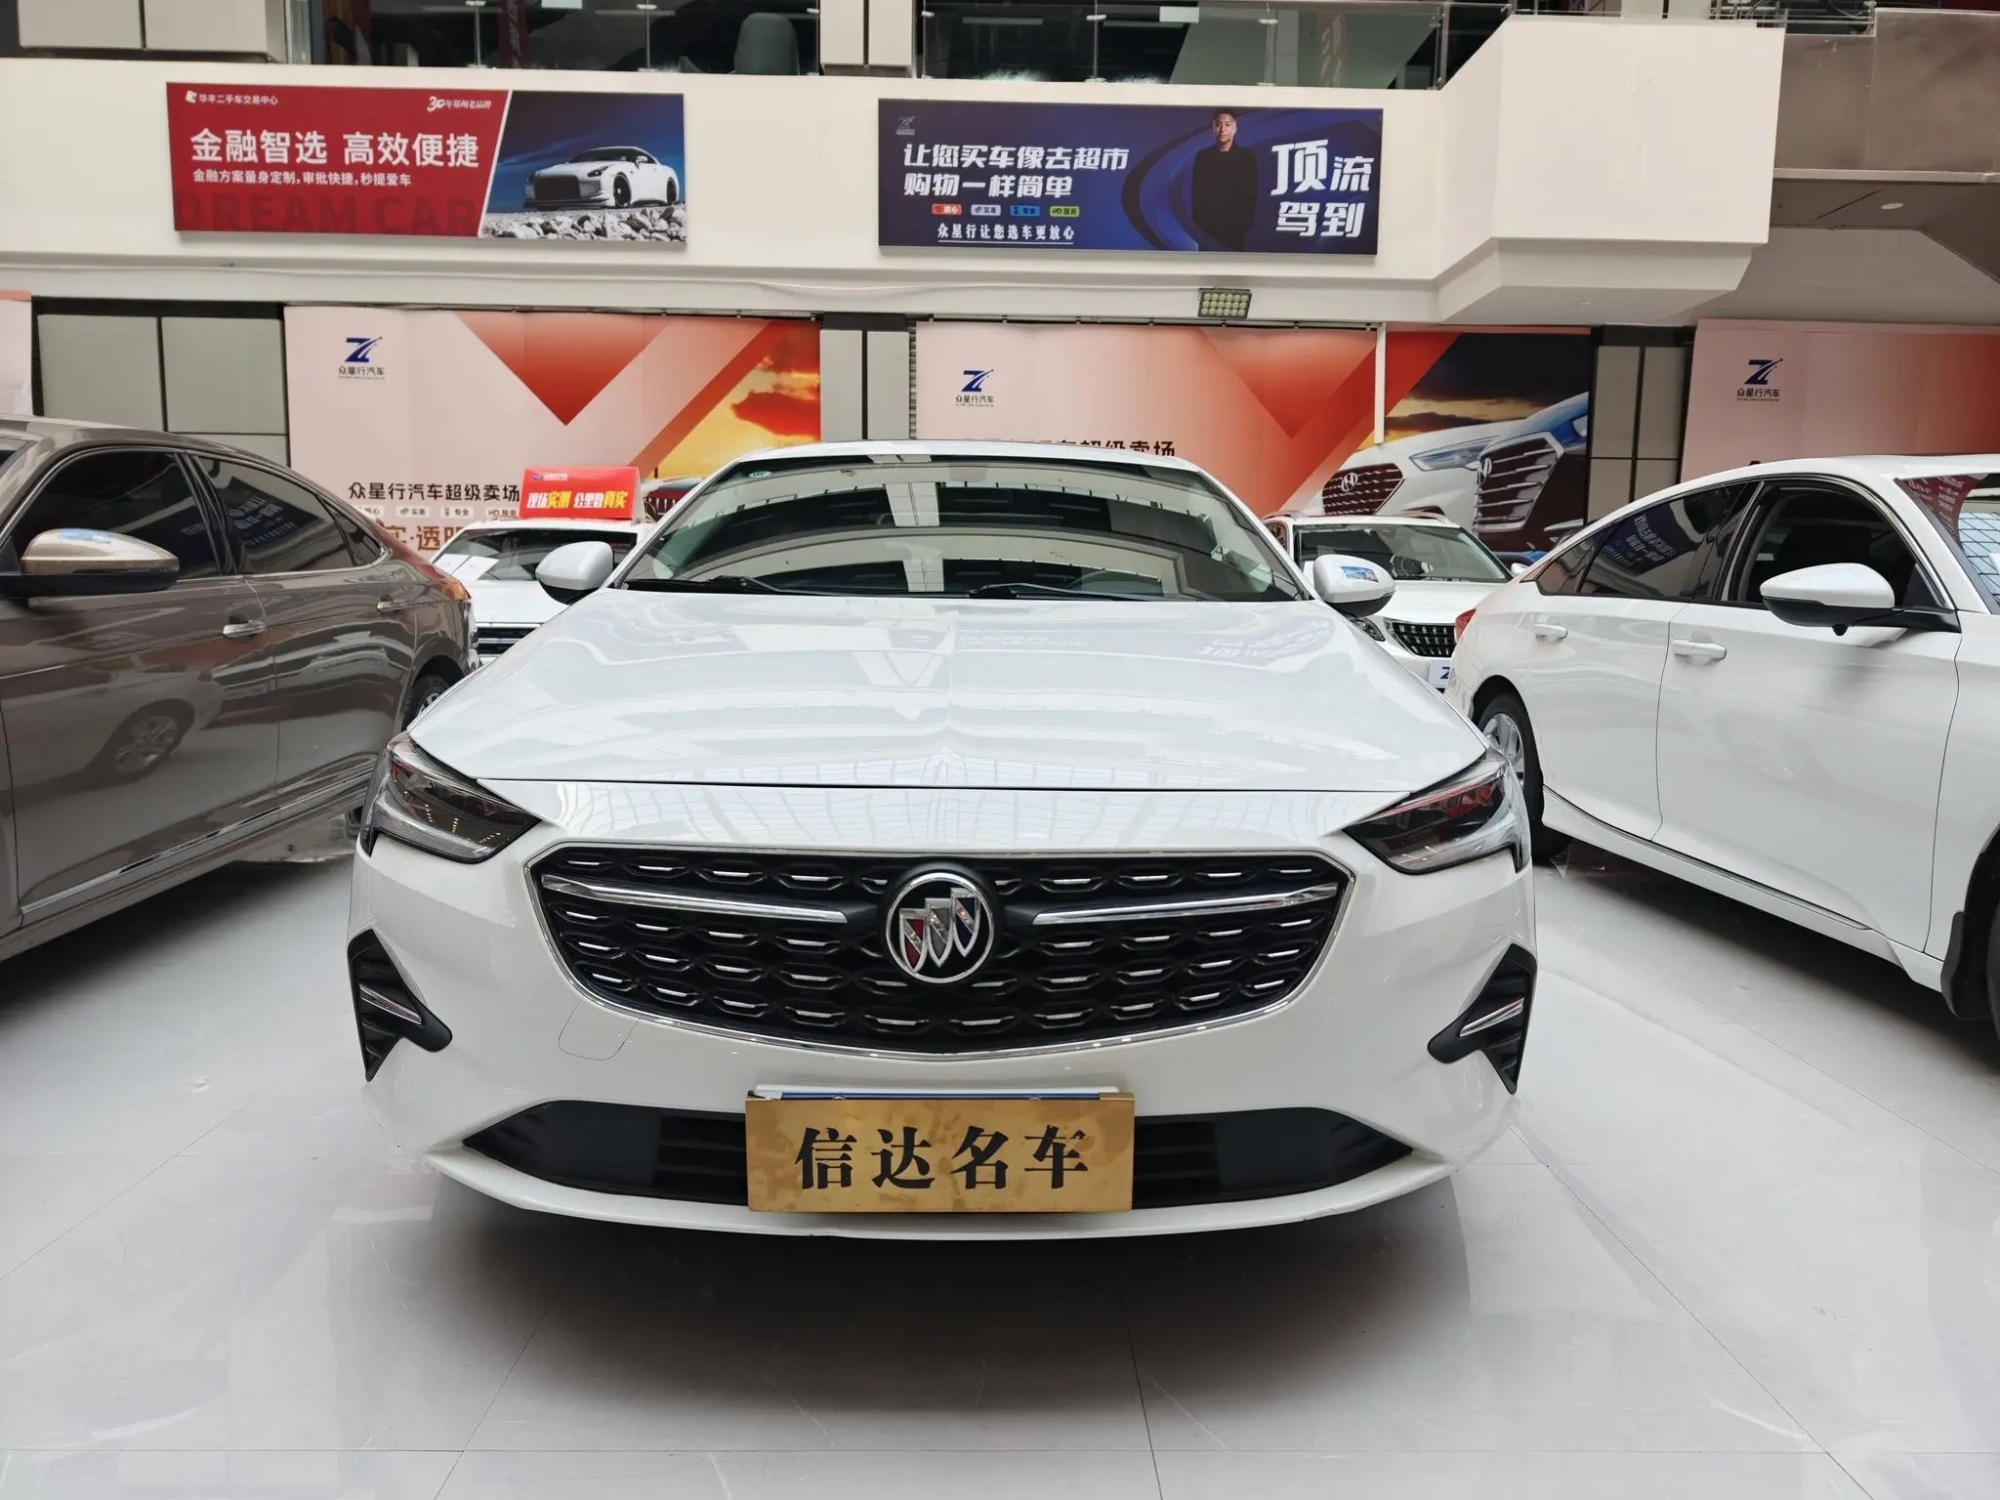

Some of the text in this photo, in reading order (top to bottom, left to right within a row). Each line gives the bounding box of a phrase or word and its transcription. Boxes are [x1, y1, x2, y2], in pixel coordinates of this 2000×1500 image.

[190, 127, 480, 168] 金融智选 高效便捷
[903, 143, 1130, 171] 让您买车像去超市
[1270, 139, 1375, 196] 顶流
[903, 173, 1073, 199] 购物一样简单
[175, 190, 477, 236] DREAM CAR
[1275, 201, 1366, 238] 驾到
[937, 222, 1075, 240] 众星行让您选车更放心
[338, 365, 386, 376] 众星行汽车
[348, 482, 520, 502] 众星行汽车超级卖场
[795, 1125, 1089, 1190] 信达名车
